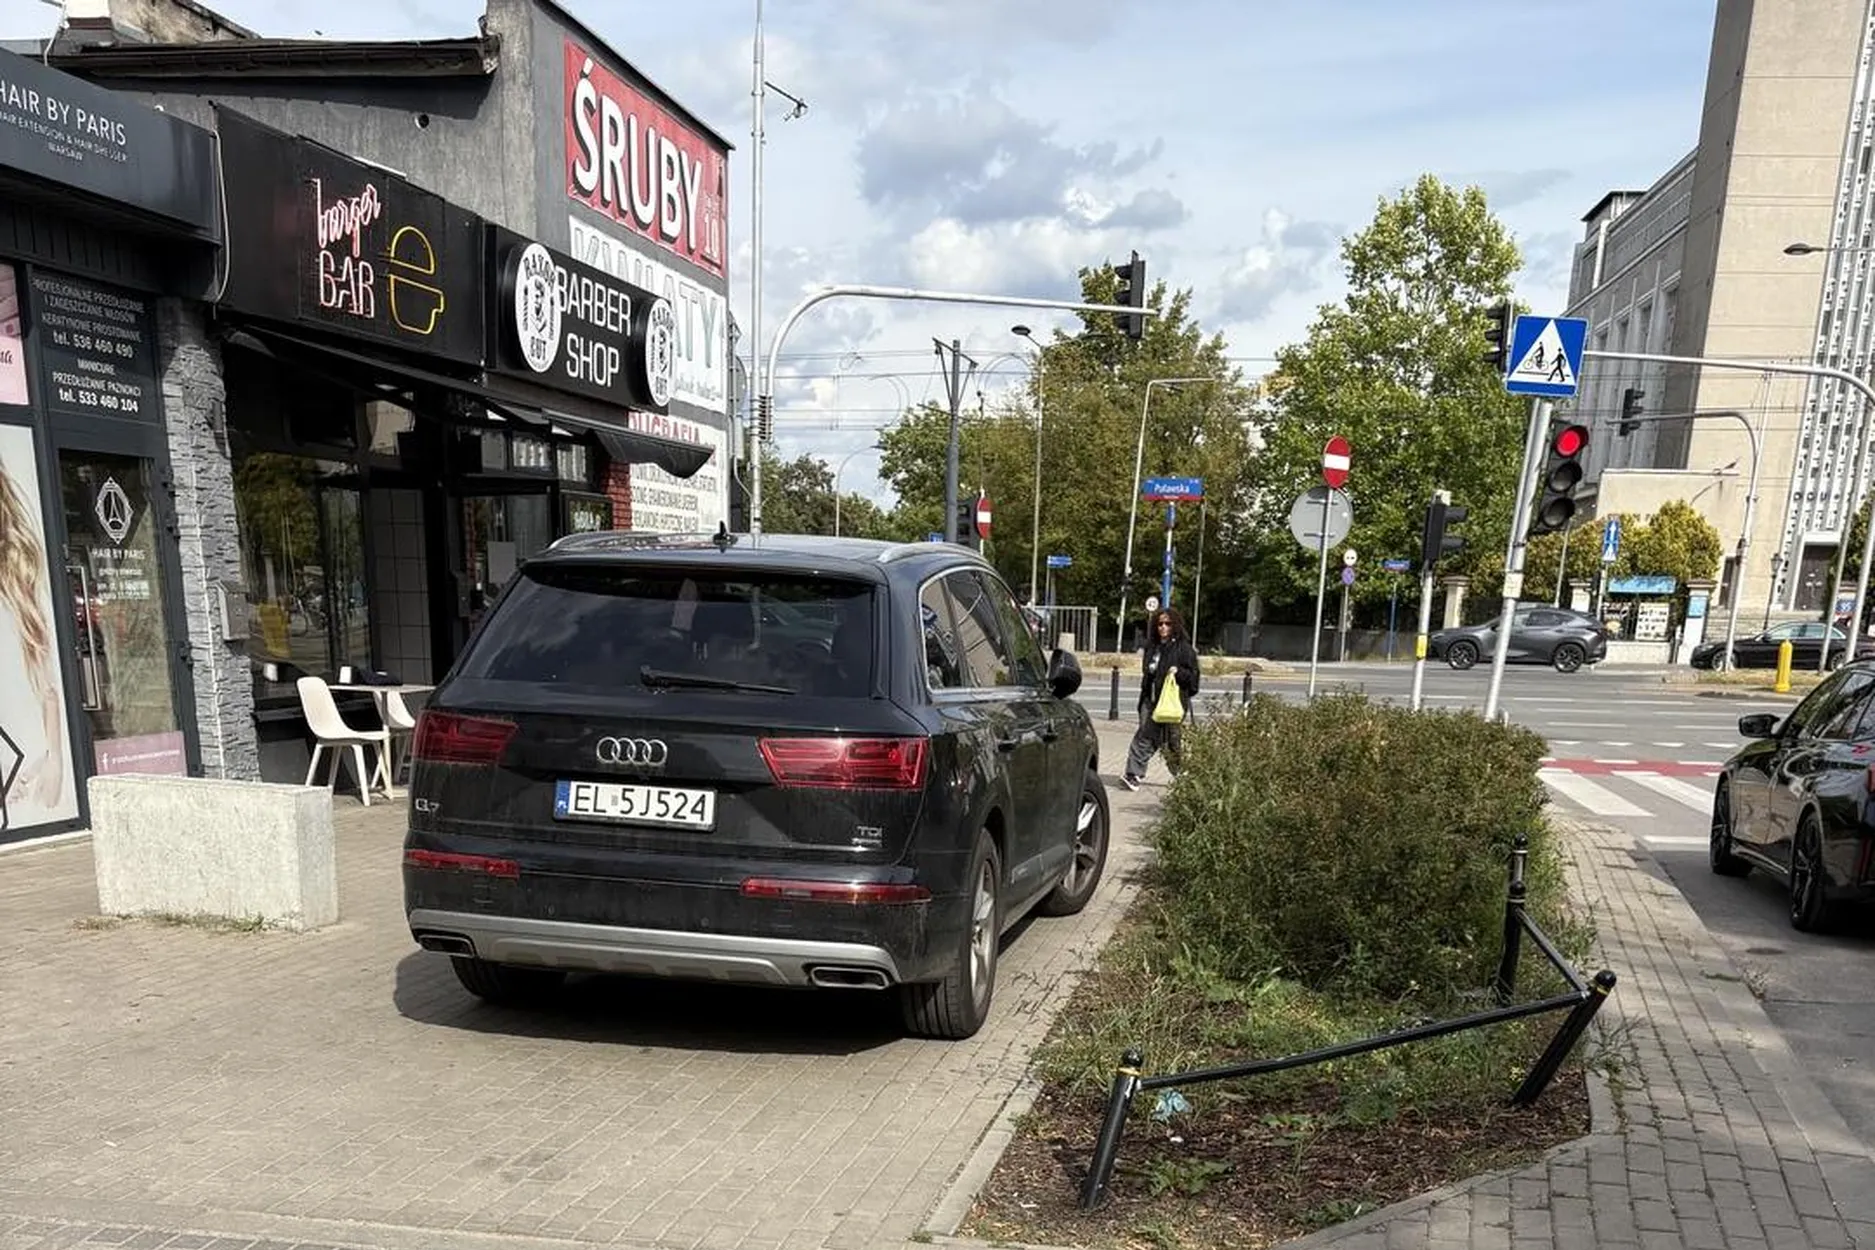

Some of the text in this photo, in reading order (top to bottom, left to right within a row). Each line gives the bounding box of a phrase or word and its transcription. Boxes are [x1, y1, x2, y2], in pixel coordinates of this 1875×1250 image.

[47, 97, 70, 124] BY
[77, 109, 126, 145] PARIS
[573, 57, 702, 253] ŚRUBY
[320, 250, 374, 318] BAR
[555, 264, 631, 337] BARBER
[566, 332, 619, 388] SHOP
[59, 387, 77, 403] tel.
[79, 390, 98, 406] 533
[121, 398, 138, 412] 104
[574, 785, 706, 822] EL 5J524
